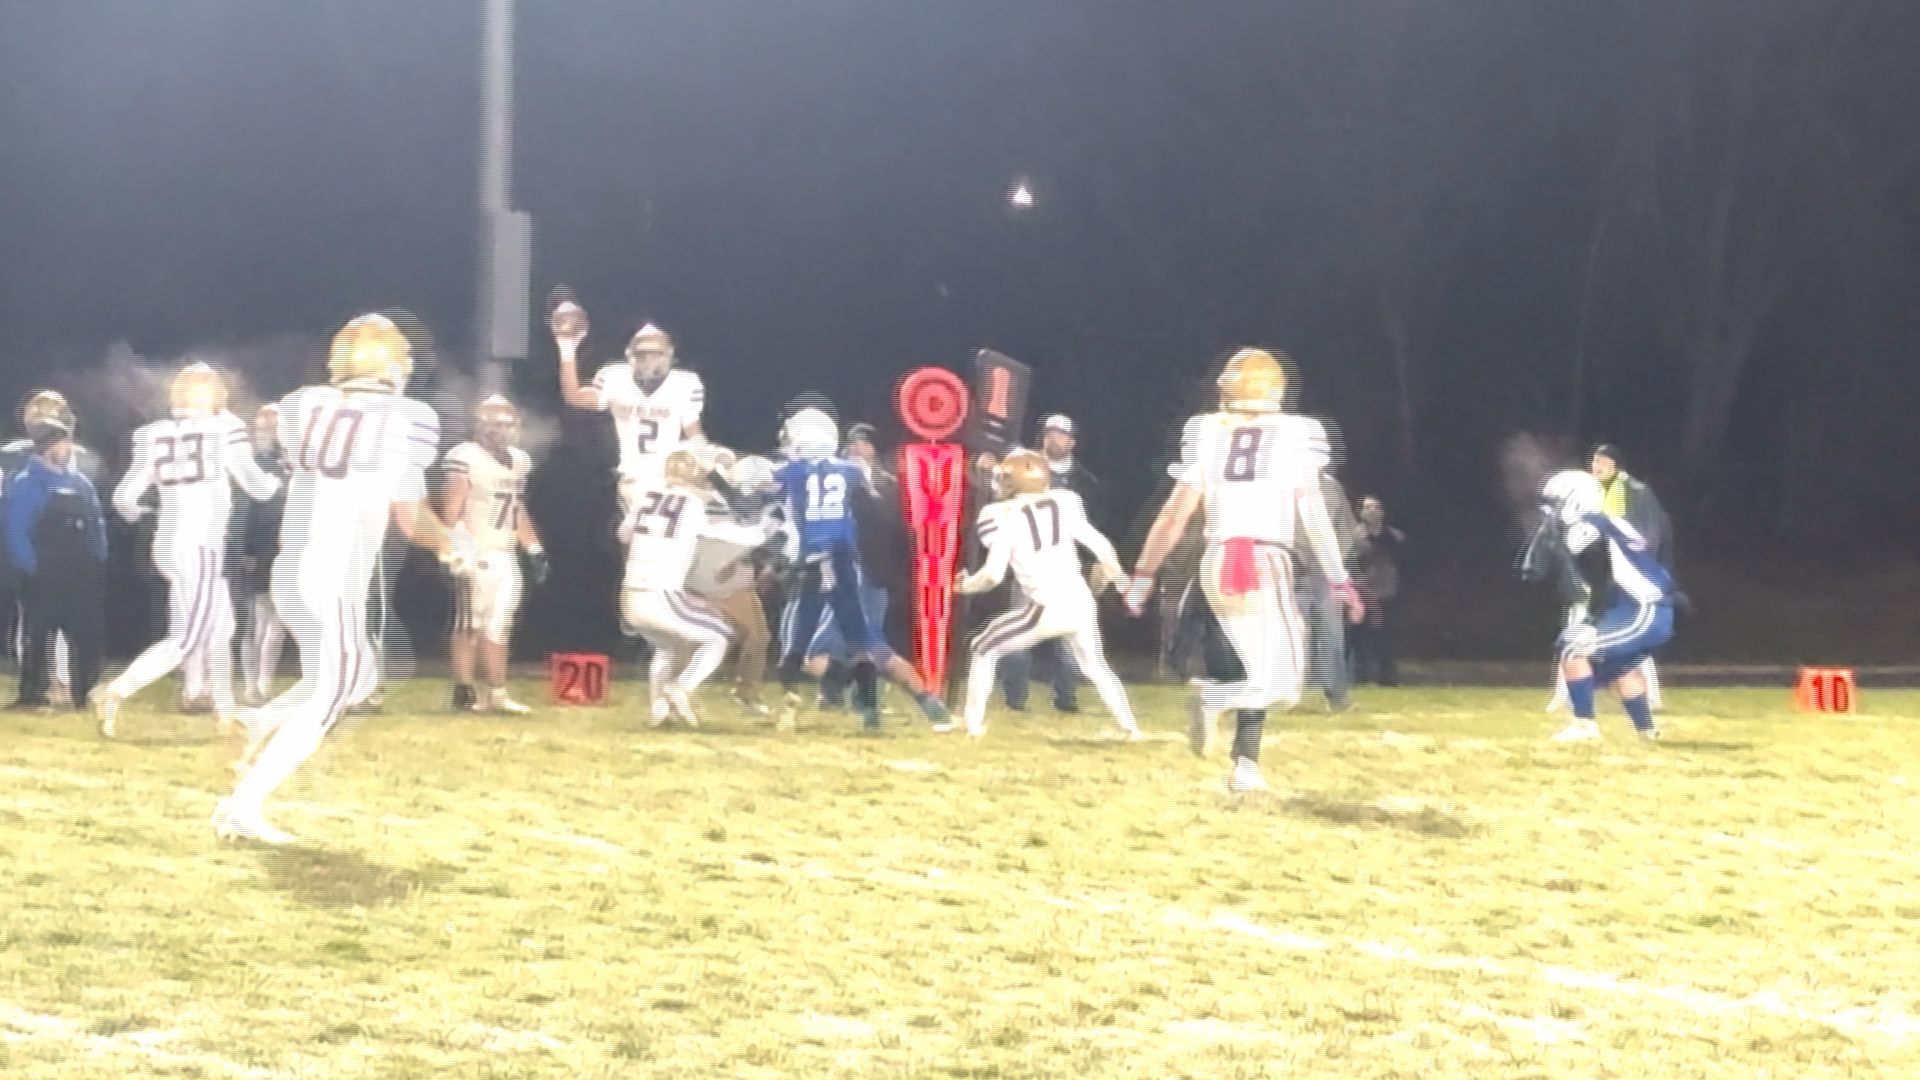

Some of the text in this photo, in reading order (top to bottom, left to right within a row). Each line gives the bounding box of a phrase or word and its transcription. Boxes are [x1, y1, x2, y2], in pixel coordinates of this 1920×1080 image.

[988, 366, 1011, 418] 1
[154, 432, 205, 486] 23
[299, 405, 363, 480] 10
[637, 418, 659, 454] 2
[1223, 426, 1264, 482] 8
[633, 491, 688, 538] 24
[805, 472, 847, 520] 12
[1020, 498, 1060, 552] 17
[558, 660, 603, 700] 20
[1811, 675, 1849, 712] 10
